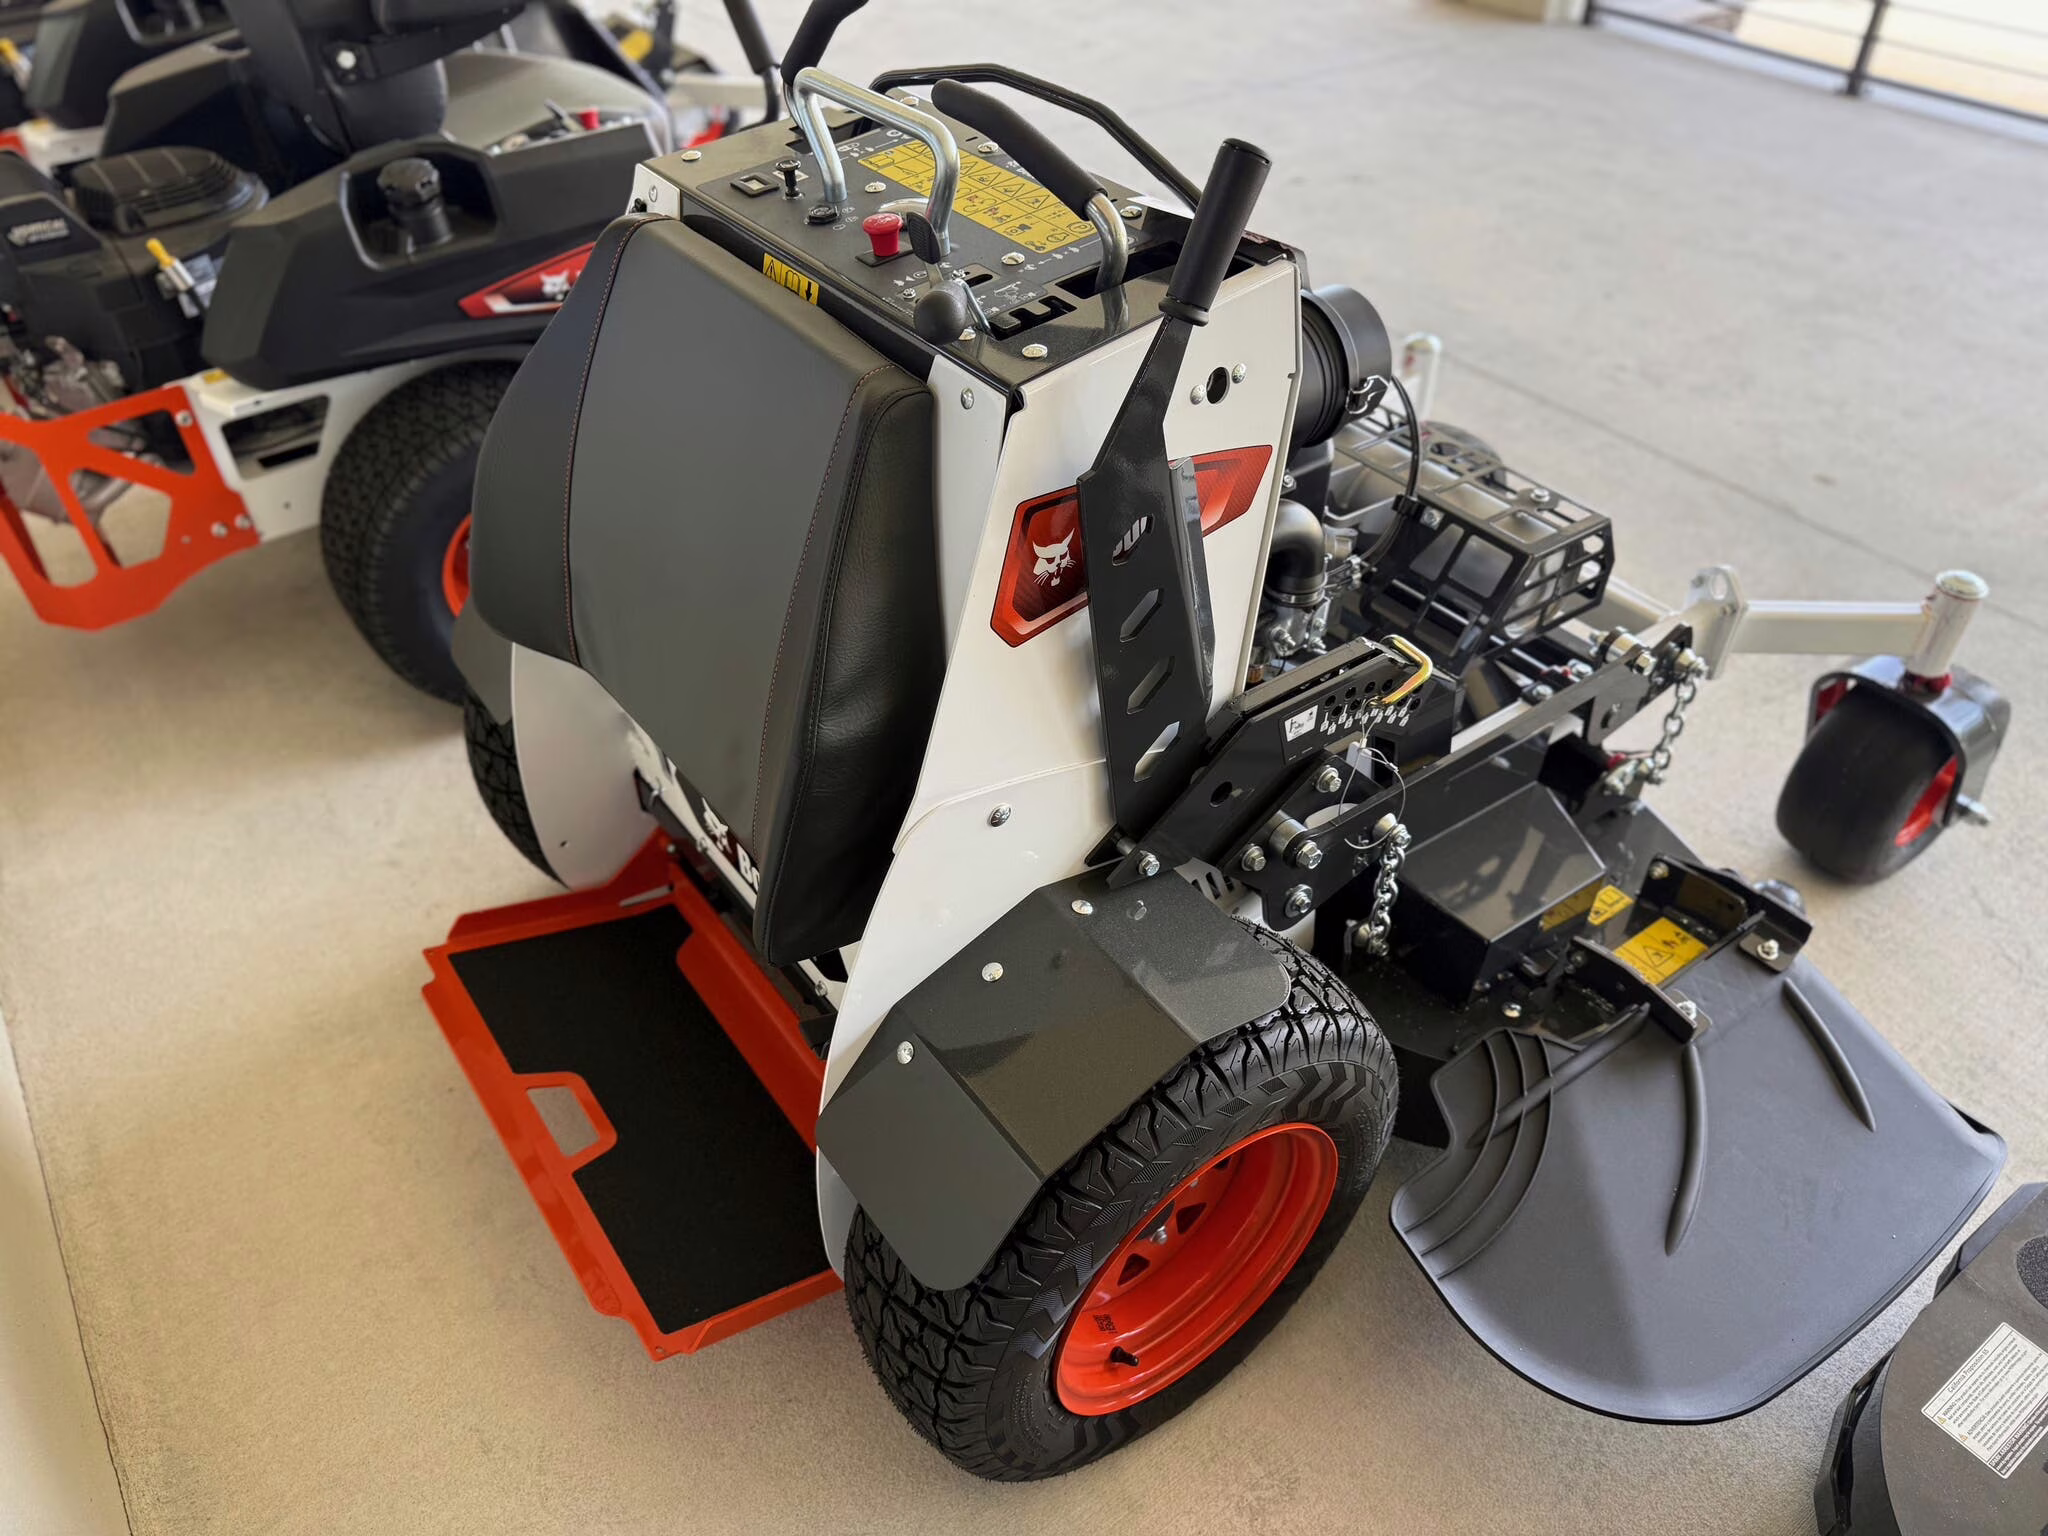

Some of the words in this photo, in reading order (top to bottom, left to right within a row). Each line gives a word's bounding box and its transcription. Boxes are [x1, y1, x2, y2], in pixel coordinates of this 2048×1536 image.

[1948, 1373, 1966, 1393] California
[1964, 1355, 1985, 1376] Proposition
[1982, 1349, 1990, 1357] 65
